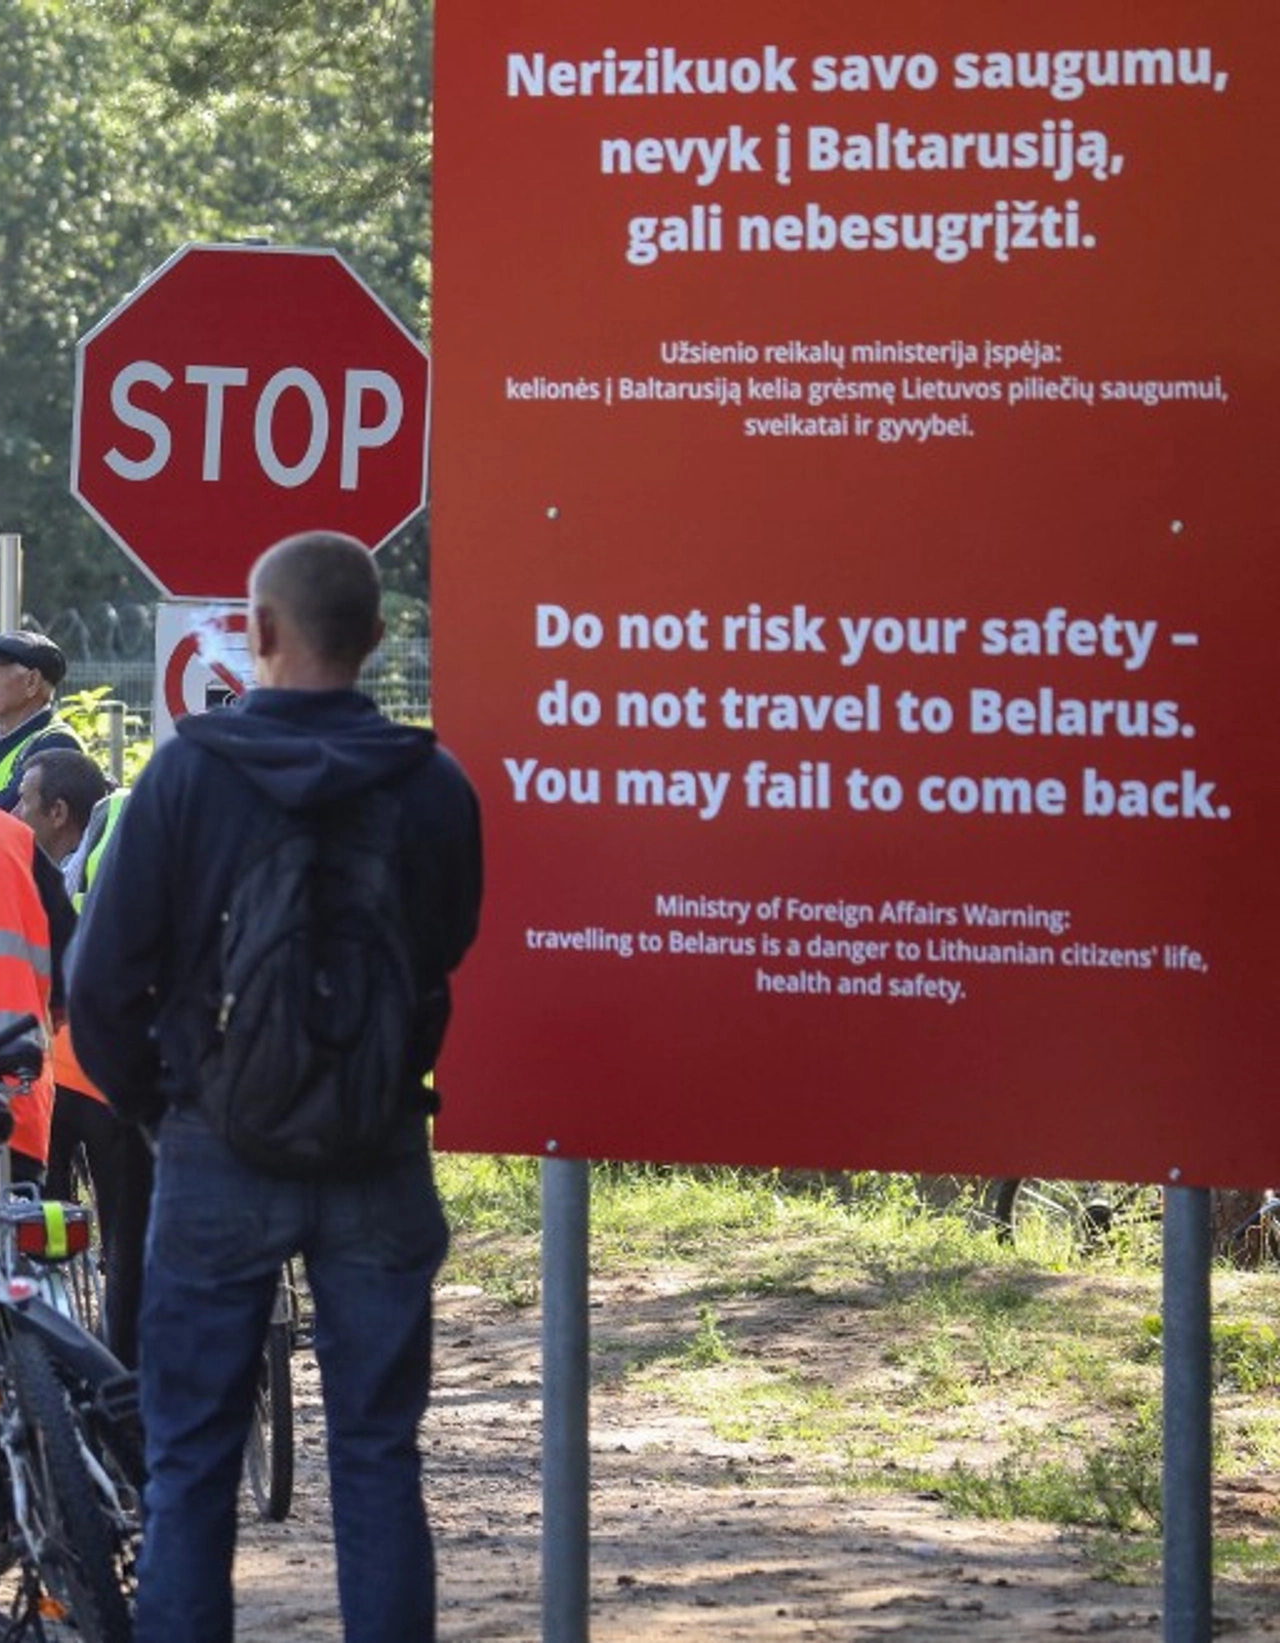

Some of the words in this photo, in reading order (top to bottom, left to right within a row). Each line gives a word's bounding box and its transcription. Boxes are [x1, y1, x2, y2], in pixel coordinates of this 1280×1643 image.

[507, 45, 798, 97] Nerizikuok
[811, 53, 939, 92] savo
[953, 47, 1228, 101] saugumu,
[600, 124, 762, 187] nevyk
[775, 123, 792, 186] į
[807, 118, 1124, 182] Baltarusiją,
[625, 203, 722, 266] gali
[738, 199, 1096, 264] nebesugrįžti.
[660, 340, 759, 364] Užsienio
[764, 340, 845, 369] reikalų
[851, 340, 978, 369] ministerija
[983, 340, 1062, 369] įspėja:
[506, 374, 601, 400] kelionės
[605, 377, 614, 406] į
[618, 376, 742, 407] Baltarusiją
[747, 376, 802, 400] kelia
[807, 377, 896, 406] grėsmę
[902, 377, 1002, 400] Lietuvos
[1008, 374, 1094, 406] piliečių
[1100, 377, 1227, 406] saugumui,
[102, 359, 405, 491] STOP
[744, 412, 849, 437] sveikatai
[854, 413, 873, 436] ir
[877, 413, 974, 443] gyvybei.
[535, 603, 604, 649] Do
[618, 609, 709, 651] not
[723, 603, 826, 652] risk
[838, 617, 967, 666] your
[982, 607, 1157, 670] safety
[537, 679, 602, 727] do
[616, 686, 707, 729] not
[719, 684, 880, 732] travel
[895, 690, 953, 733] to
[970, 687, 1194, 737] Belarus.
[503, 758, 600, 804] You
[616, 769, 731, 820] may
[743, 760, 830, 809] fail
[845, 768, 903, 811] to
[918, 775, 1066, 815] come
[1083, 768, 1231, 819] back.
[656, 894, 751, 925] Ministry
[756, 897, 781, 920] of
[787, 898, 874, 928] Foreign
[879, 900, 957, 925] Affairs
[963, 904, 1069, 934] Warning:
[526, 927, 634, 957] travelling
[638, 932, 663, 952] to
[669, 930, 756, 956] Belarus
[762, 935, 781, 956] is
[786, 939, 800, 956] a
[807, 937, 889, 964] danger
[896, 941, 921, 960] to
[927, 939, 1054, 965] Lithuanian
[1061, 944, 1156, 968] citizens'
[1165, 946, 1208, 972] life,
[757, 969, 831, 994] health
[837, 973, 882, 995] and
[889, 974, 965, 1003] safety.
